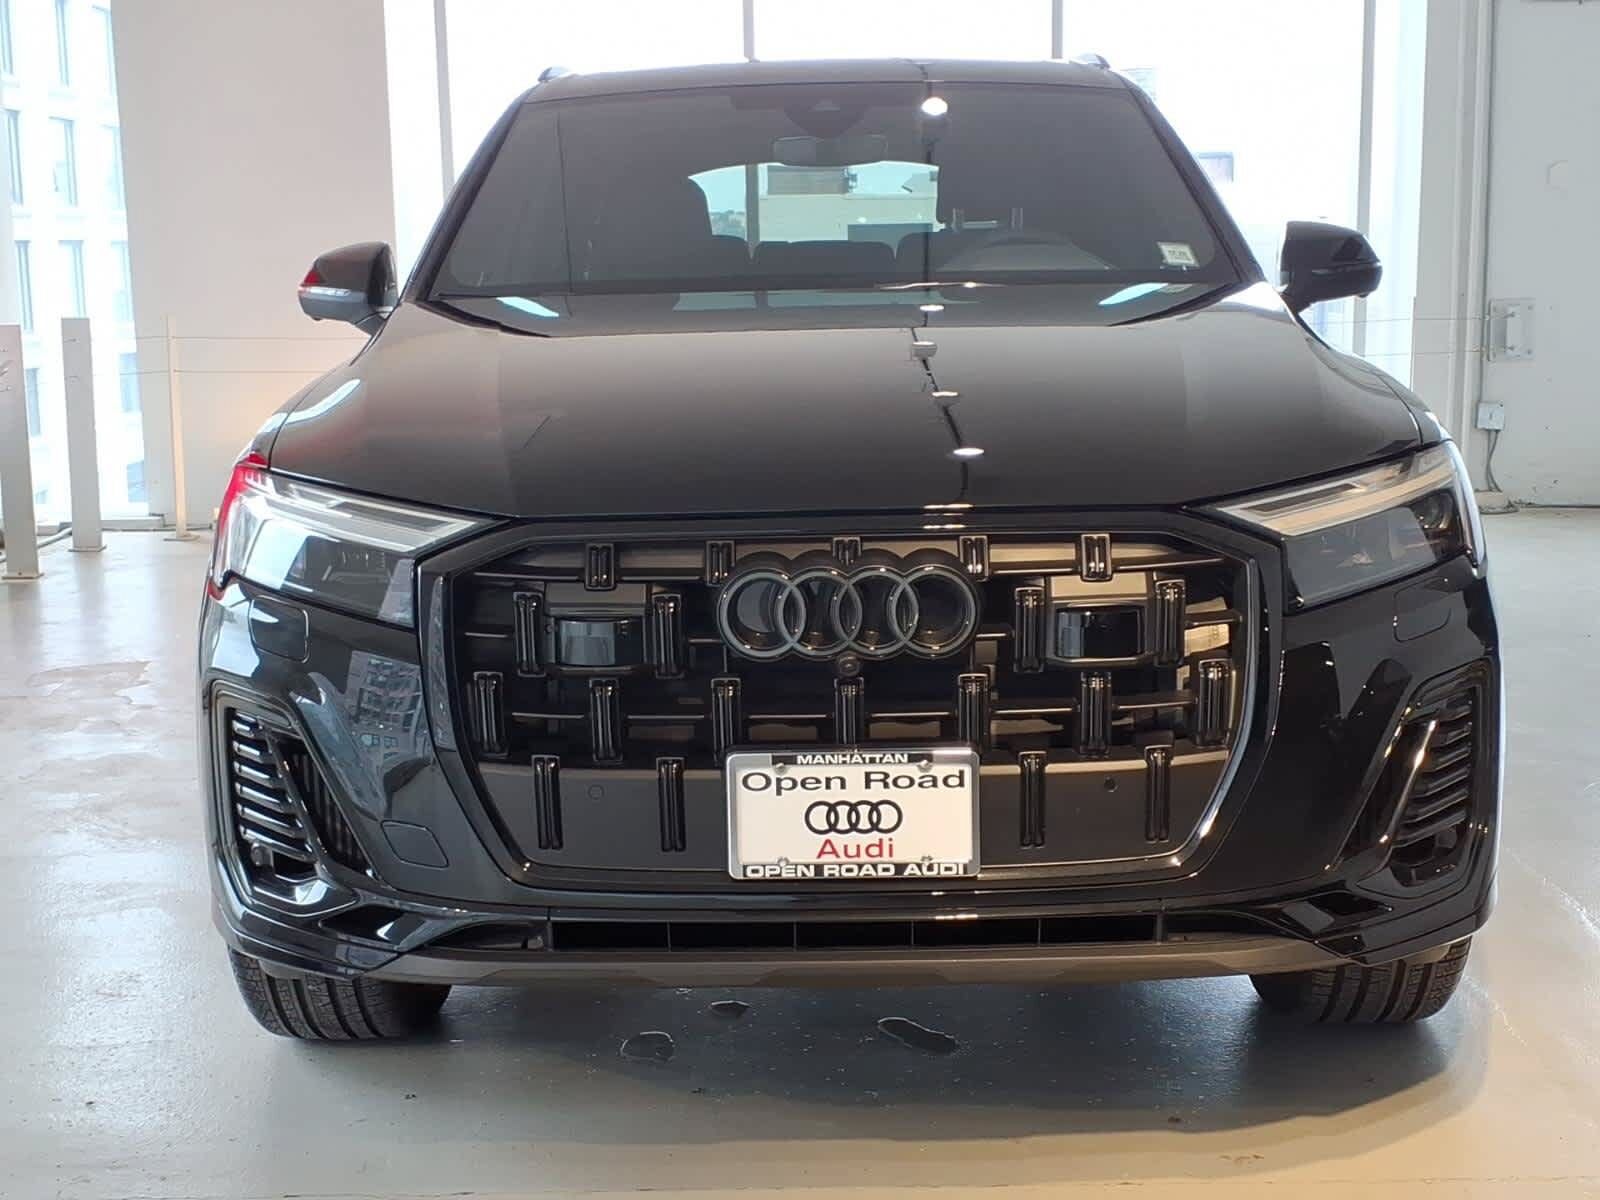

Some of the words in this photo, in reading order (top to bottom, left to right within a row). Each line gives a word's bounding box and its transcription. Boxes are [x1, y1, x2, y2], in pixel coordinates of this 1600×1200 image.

[797, 753, 909, 765] MANHATTAN
[741, 772, 847, 797] Open
[864, 769, 965, 790] Road
[816, 838, 894, 860] Audi
[746, 864, 815, 878] OPEN
[823, 863, 896, 877] ROAD
[904, 862, 965, 876] AUDI
